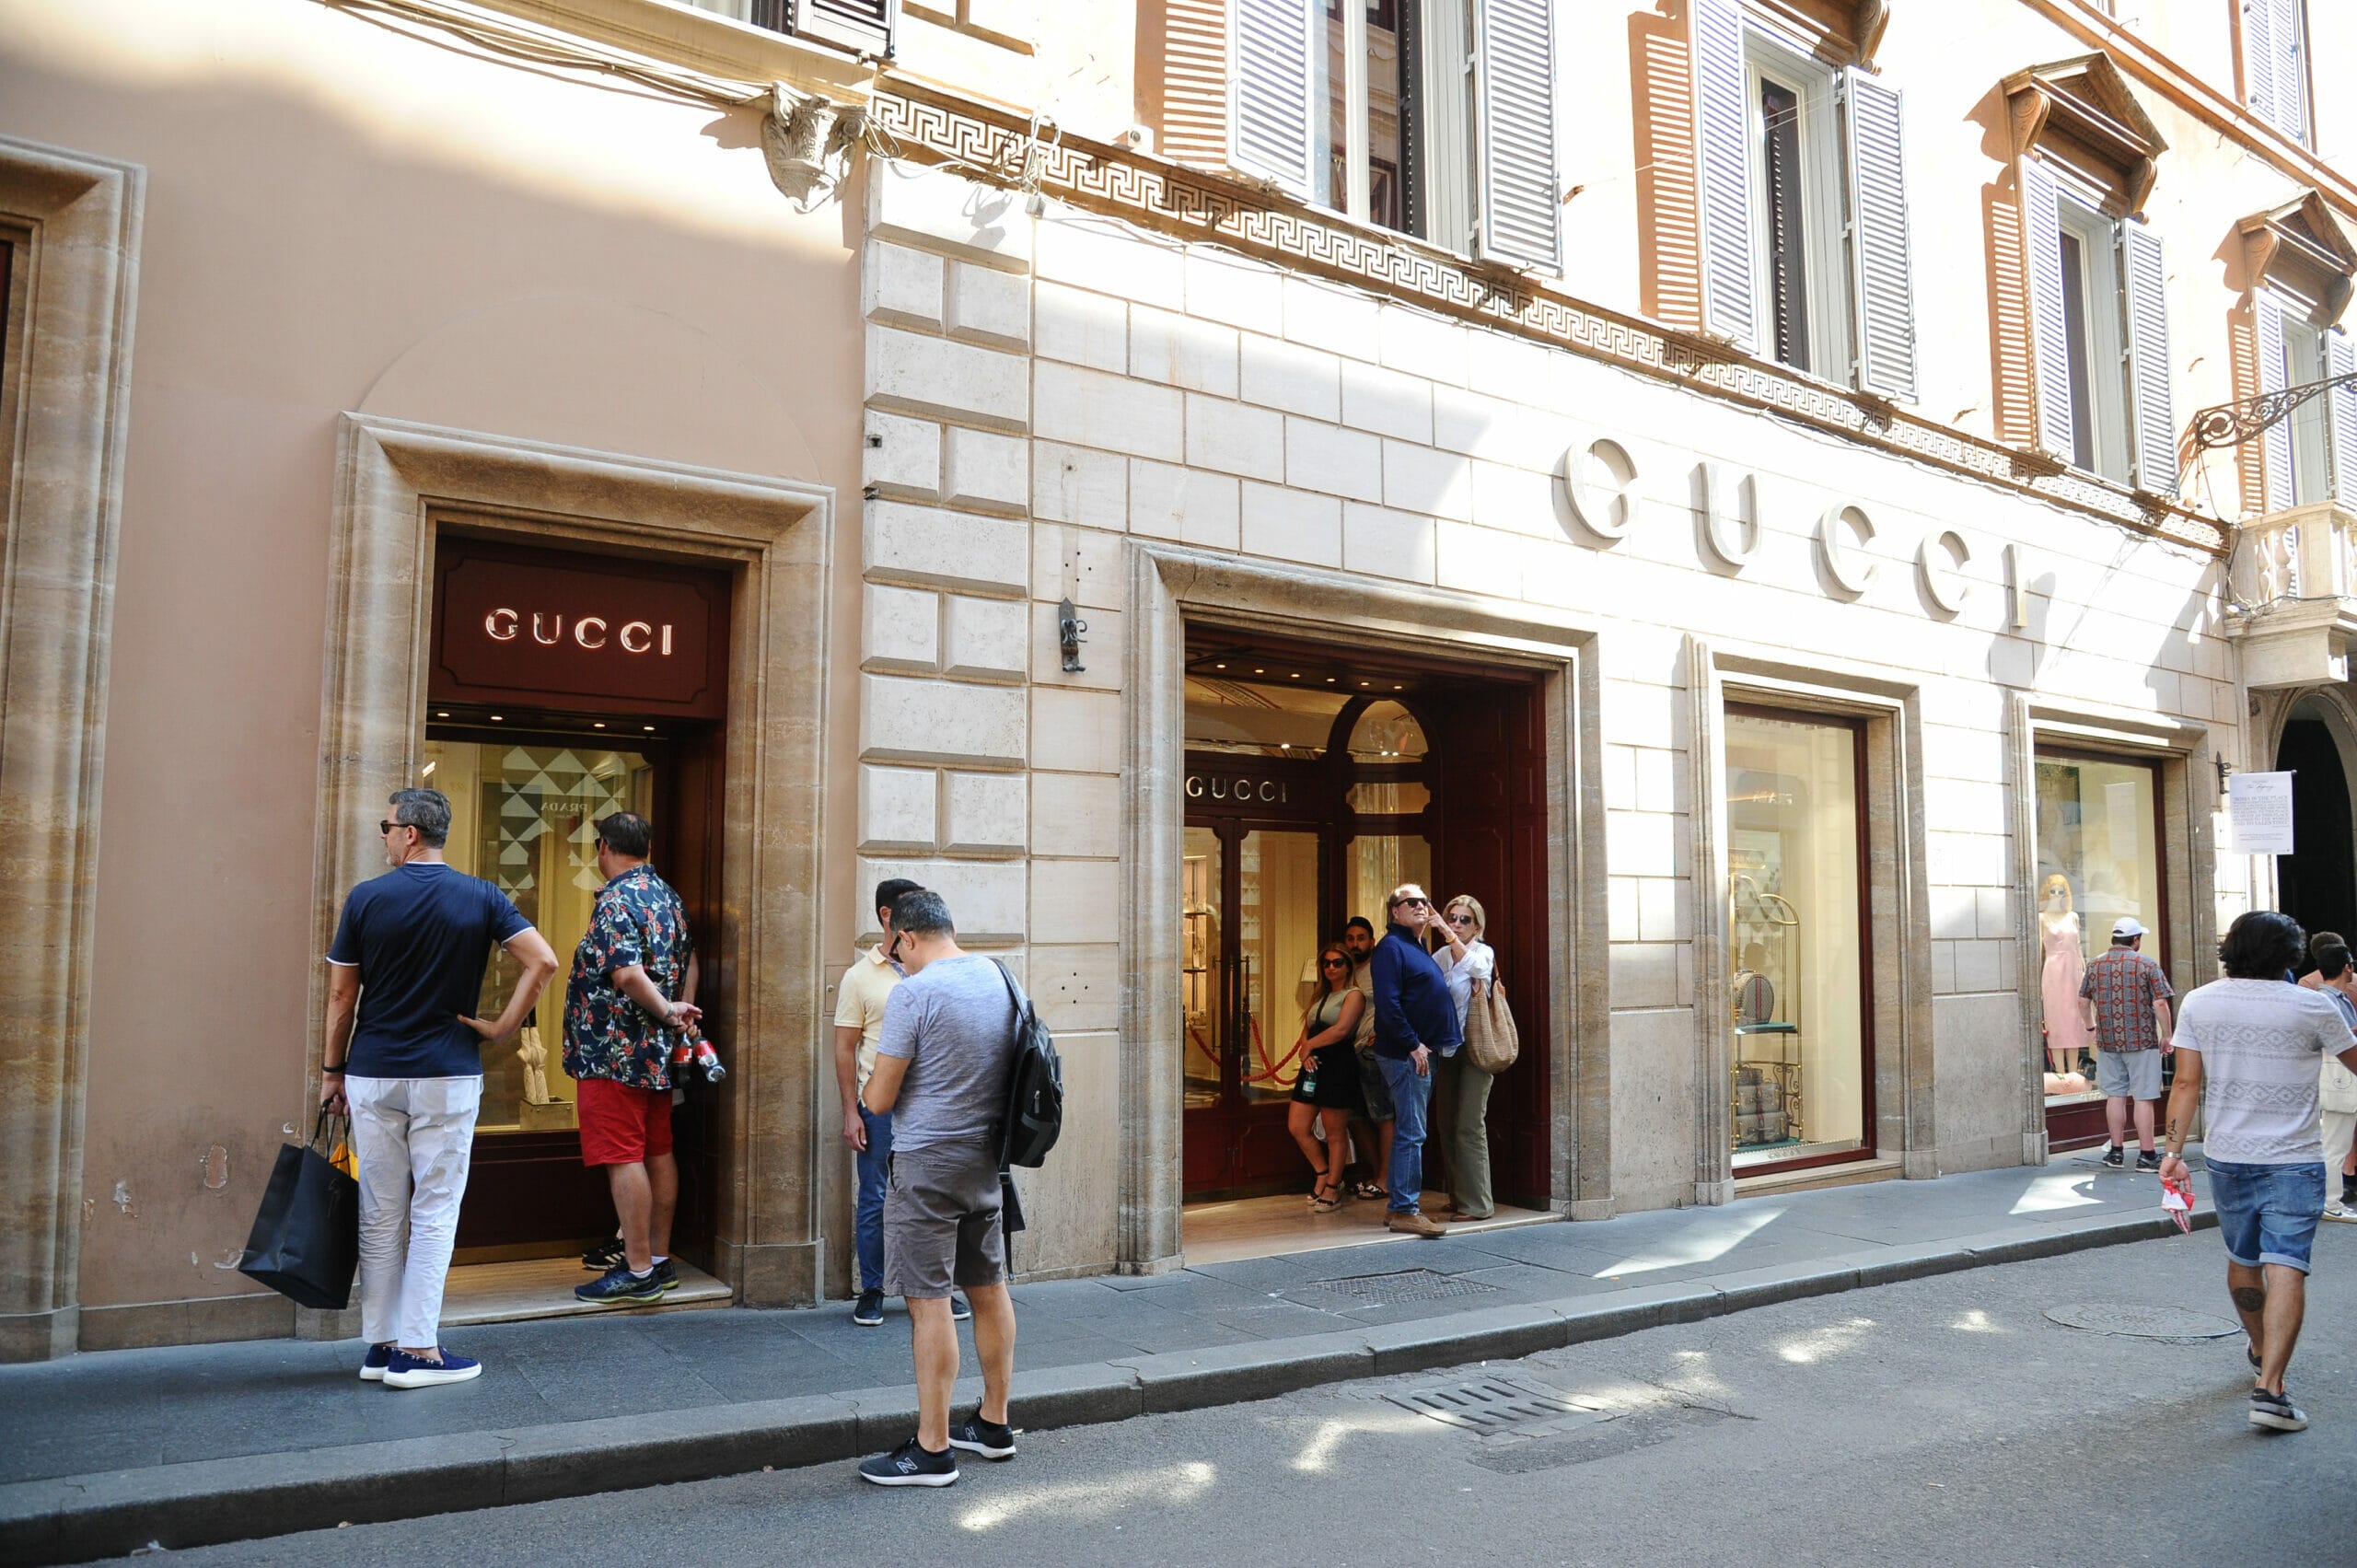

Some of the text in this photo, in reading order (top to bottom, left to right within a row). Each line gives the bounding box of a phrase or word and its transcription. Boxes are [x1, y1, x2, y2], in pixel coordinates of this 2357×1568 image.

[1556, 437, 2029, 628] GUCCI
[485, 608, 673, 656] GUCCI
[1185, 776, 1287, 803] GUCCI
